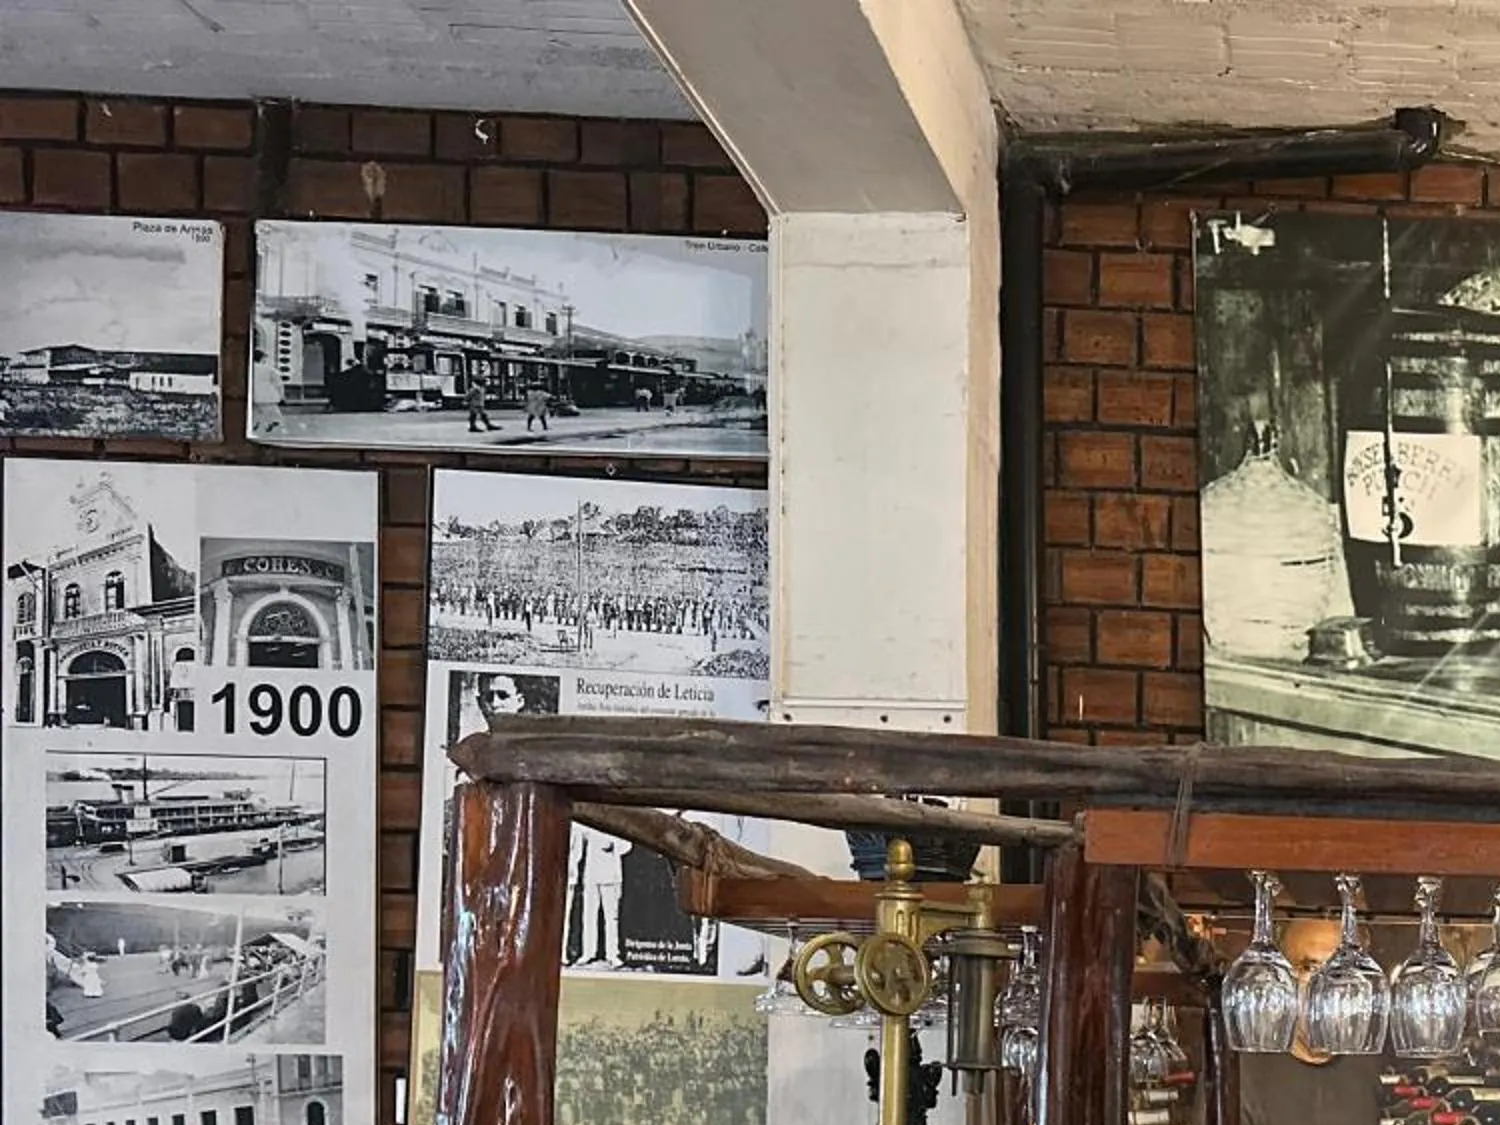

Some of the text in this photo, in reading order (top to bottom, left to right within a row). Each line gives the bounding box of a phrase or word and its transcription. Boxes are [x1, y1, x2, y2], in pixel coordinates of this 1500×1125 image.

[132, 221, 162, 233] Plaza
[243, 557, 312, 574] COHEN
[576, 677, 715, 702] Recuperación de Leticia
[211, 682, 362, 738] 1900
